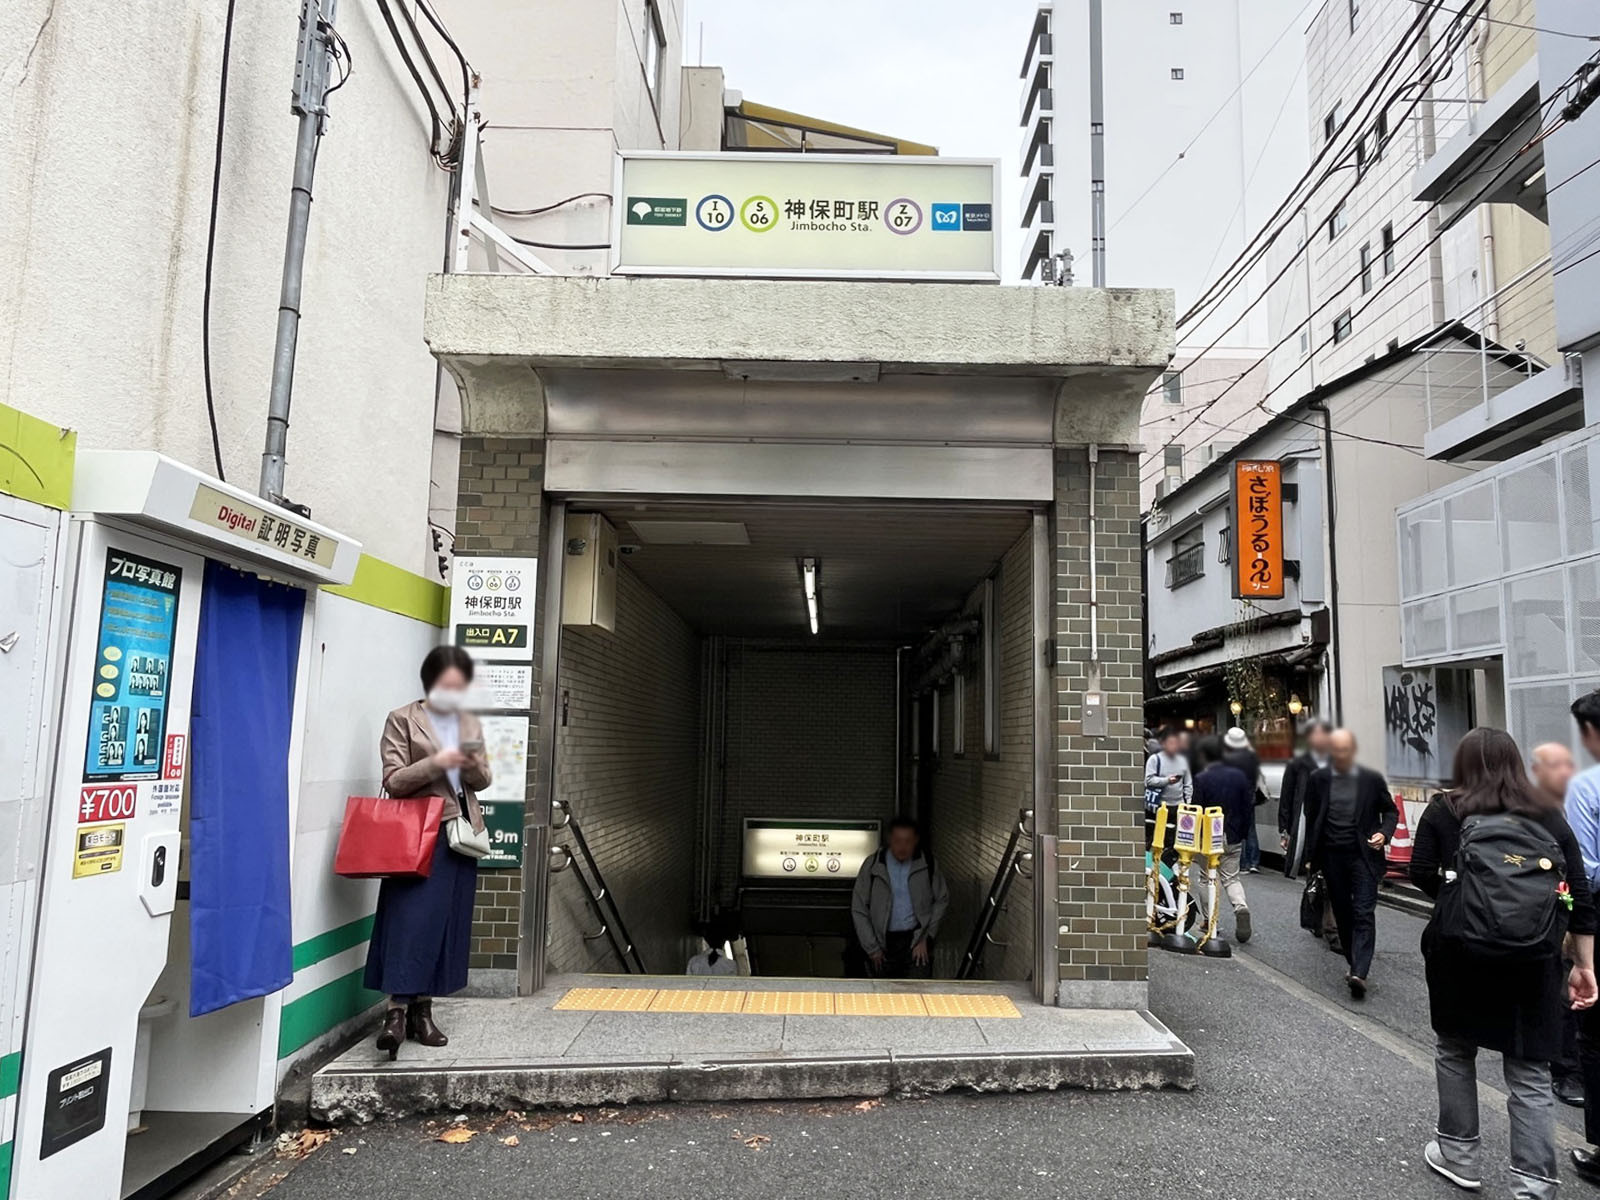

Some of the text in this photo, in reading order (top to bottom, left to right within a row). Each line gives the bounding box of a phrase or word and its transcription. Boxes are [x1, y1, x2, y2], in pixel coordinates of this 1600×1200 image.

[712, 201, 718, 211] I
[756, 202, 764, 212] S
[784, 199, 879, 221] 神保町駅
[899, 205, 908, 214] Z
[707, 212, 724, 224] 10
[750, 213, 769, 224] 06
[894, 216, 913, 227] 07
[790, 221, 873, 232] Jimbocho Sta.
[217, 505, 321, 559] Digital 証明写真
[110, 557, 176, 589] プロ写真館
[465, 595, 522, 610] 神保町駅
[466, 627, 490, 637] 出入口
[491, 628, 519, 644] A7
[81, 788, 136, 820] ¥700
